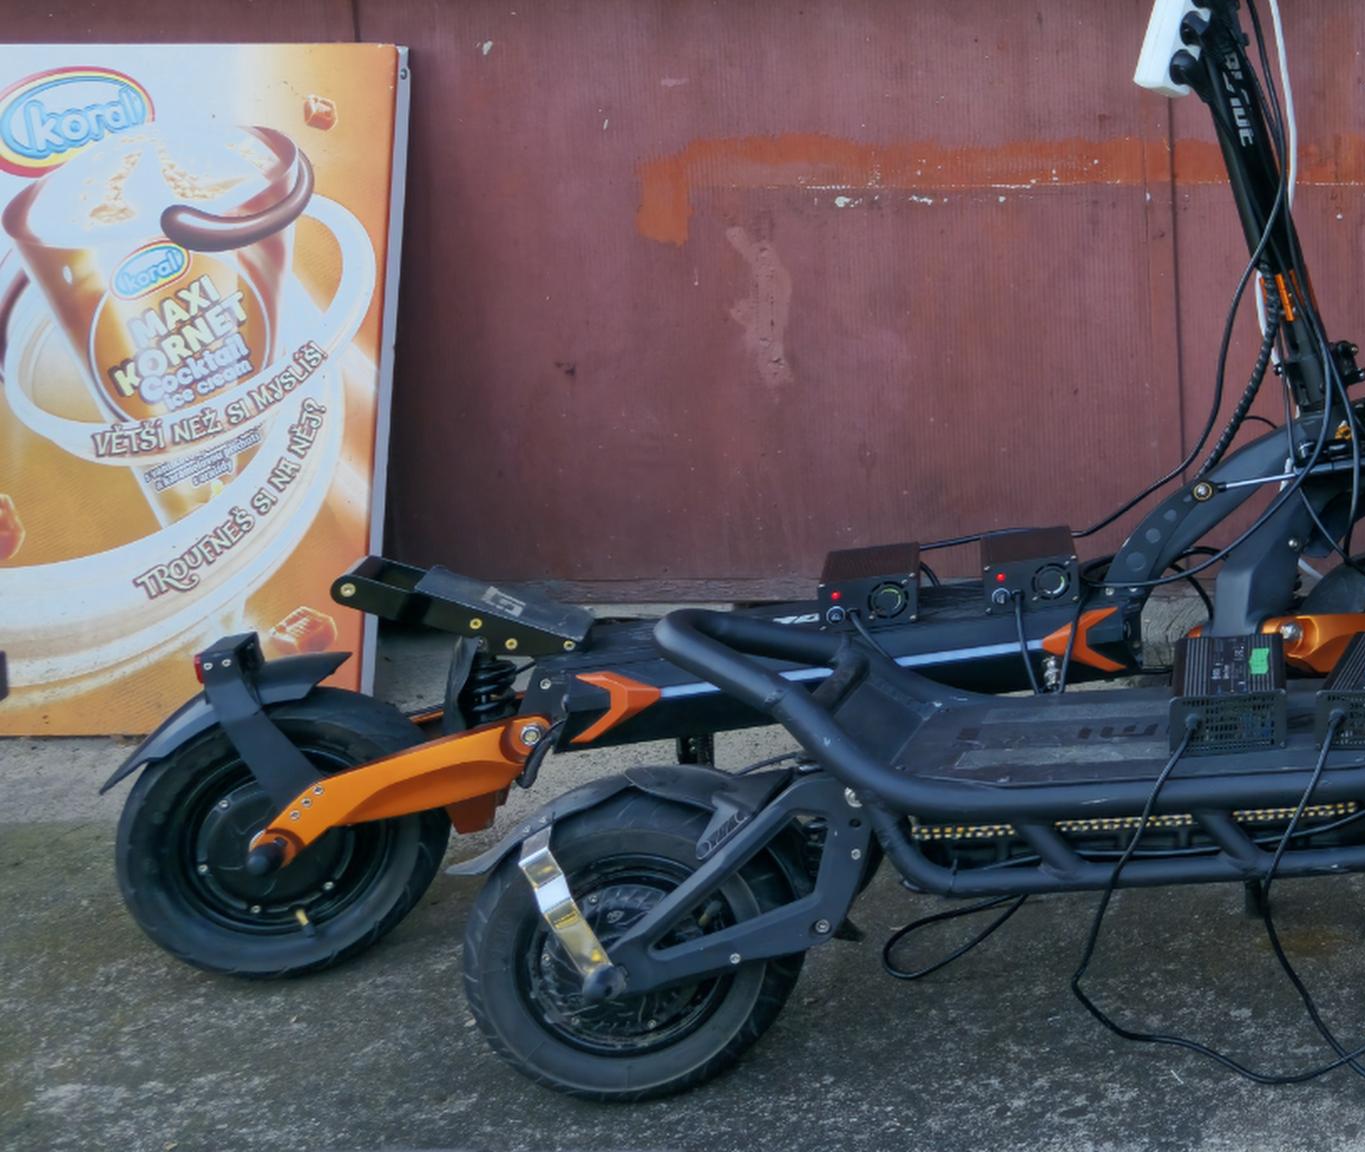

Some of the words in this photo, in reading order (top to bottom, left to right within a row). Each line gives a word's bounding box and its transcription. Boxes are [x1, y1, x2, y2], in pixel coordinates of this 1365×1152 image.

[25, 86, 142, 154] koral
[122, 251, 181, 292] koral
[112, 291, 248, 397] KORNET
[129, 273, 221, 347] MAXI
[139, 333, 250, 405] Cocktail
[162, 387, 195, 411] ice
[197, 360, 254, 395] cream
[92, 418, 166, 458] VĚTŠÍ
[171, 406, 224, 445] NEŽ
[225, 398, 254, 425] SI
[134, 505, 257, 600] TROUFNEŠ
[250, 486, 279, 516] SI
[267, 457, 303, 493] NA
